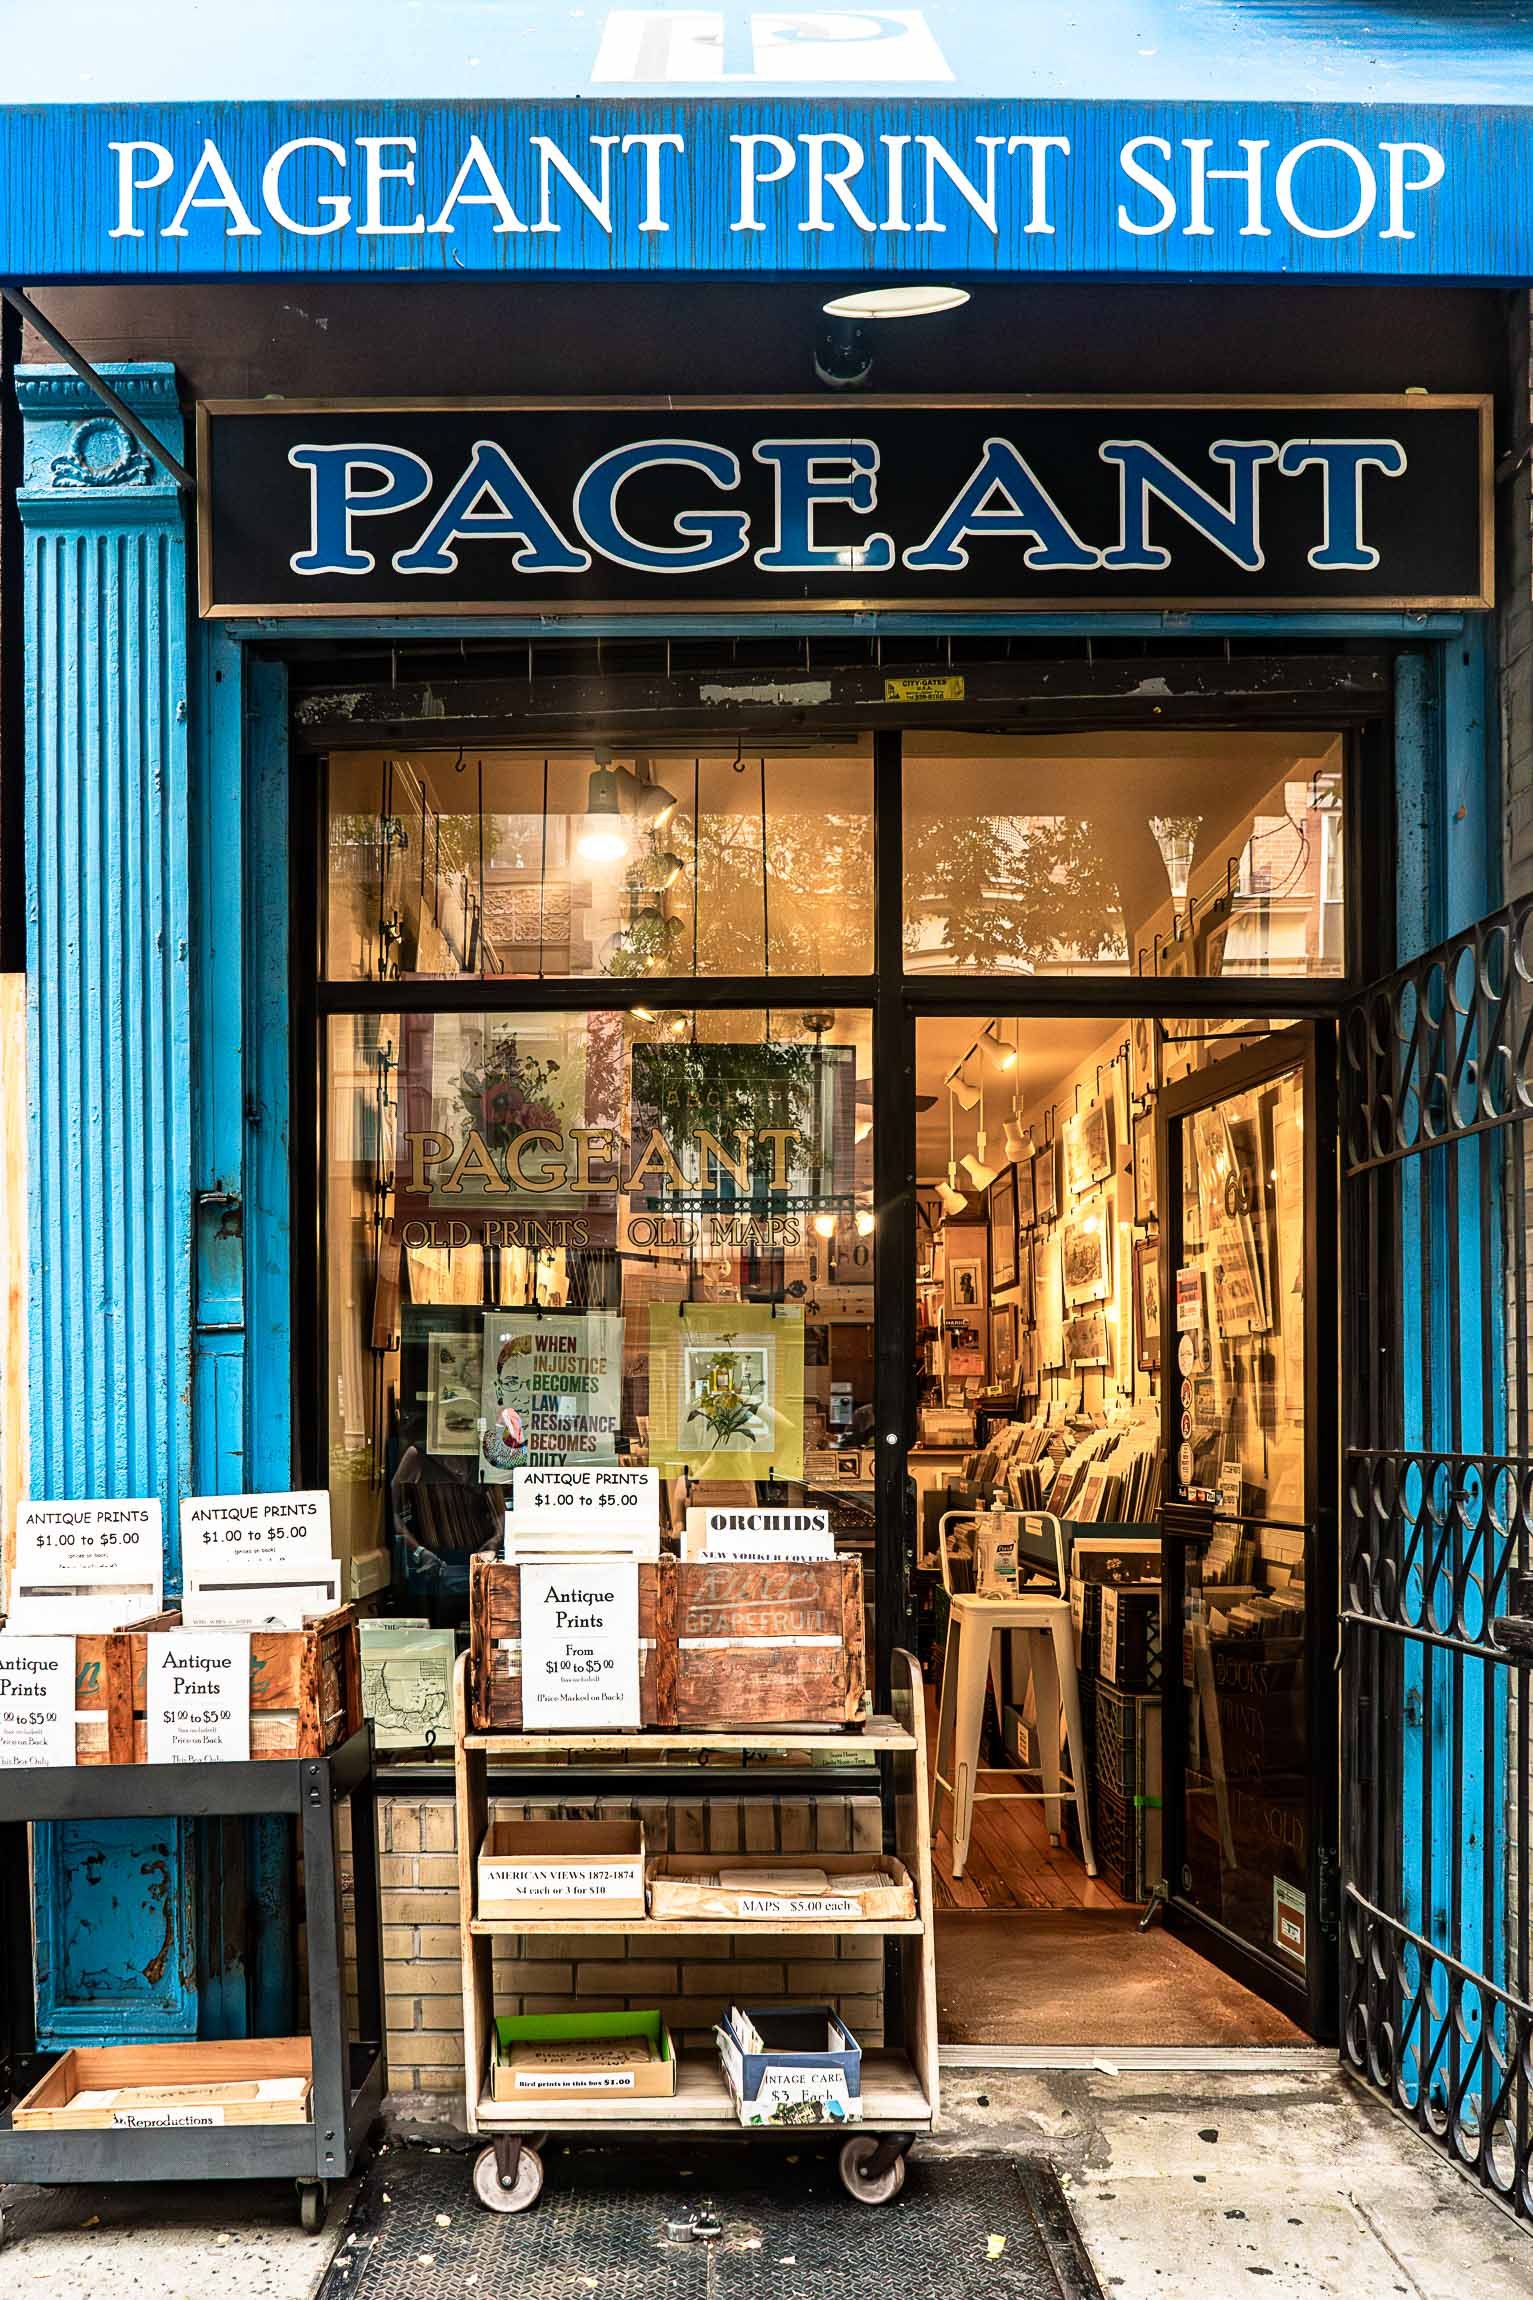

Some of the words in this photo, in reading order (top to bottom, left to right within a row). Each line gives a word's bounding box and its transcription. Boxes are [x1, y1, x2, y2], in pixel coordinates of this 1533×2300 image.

[108, 133, 684, 237] PAGEANT
[730, 133, 1070, 236] PRINT
[1117, 135, 1445, 240] SHOP
[288, 438, 1407, 575] PAGEANT
[403, 1128, 801, 1193] PAGEANT
[401, 1220, 472, 1249] OLD
[482, 1219, 590, 1248] PRINTS
[628, 1218, 698, 1248] OLD
[710, 1218, 801, 1248] MAPS
[535, 1335, 577, 1354] WHEN
[533, 1355, 607, 1375] INJUSTICE
[532, 1374, 600, 1394] BECOMES
[531, 1394, 559, 1412] LAW
[531, 1413, 616, 1433] RESISTANCE
[530, 1433, 597, 1453] BECOMES
[529, 1452, 567, 1467] DUTY
[524, 1473, 591, 1486] ANTIQUE
[596, 1473, 649, 1485] PRINTS
[535, 1494, 574, 1507] $1.00
[579, 1496, 593, 1506] to
[598, 1494, 638, 1507] $5.00
[26, 1512, 92, 1526] ANTIQUE
[97, 1510, 149, 1523] PRINTS
[191, 1506, 259, 1521] ANTIQUE
[264, 1504, 317, 1517] PRINTS
[711, 1514, 825, 1531] ORCHIDS
[36, 1534, 75, 1548] $1.00
[81, 1535, 94, 1545] to
[100, 1532, 140, 1547] $5.00
[202, 1529, 242, 1544] $1.00
[248, 1531, 261, 1541] to
[267, 1526, 307, 1540] $5.00
[544, 1586, 614, 1606] Antique
[556, 1611, 603, 1628] Prints
[686, 1611, 826, 1633] GRAPEFRUIT
[566, 1644, 594, 1656] From
[162, 1651, 231, 1672] Antique
[573, 1663, 584, 1673] to
[0, 1679, 47, 1696] Prints
[173, 1677, 220, 1694] Prints
[17, 1714, 28, 1724] to
[190, 1713, 201, 1723] to
[488, 1871, 547, 1880] AMERICAN
[550, 1871, 586, 1880] VIEWS
[588, 1871, 634, 1880] 1872-1874
[529, 1886, 550, 1894] each
[574, 1886, 587, 1894] for
[743, 1901, 780, 1912] MAPS
[790, 1901, 822, 1912] $5.00
[825, 1900, 850, 1911] each
[538, 2080, 561, 2088] prints
[604, 2078, 631, 2086] $1.00
[765, 2075, 805, 2085] INTAGE
[771, 2090, 790, 2102] $3
[802, 2089, 833, 2101] Each
[127, 2113, 213, 2128] Reproductions
